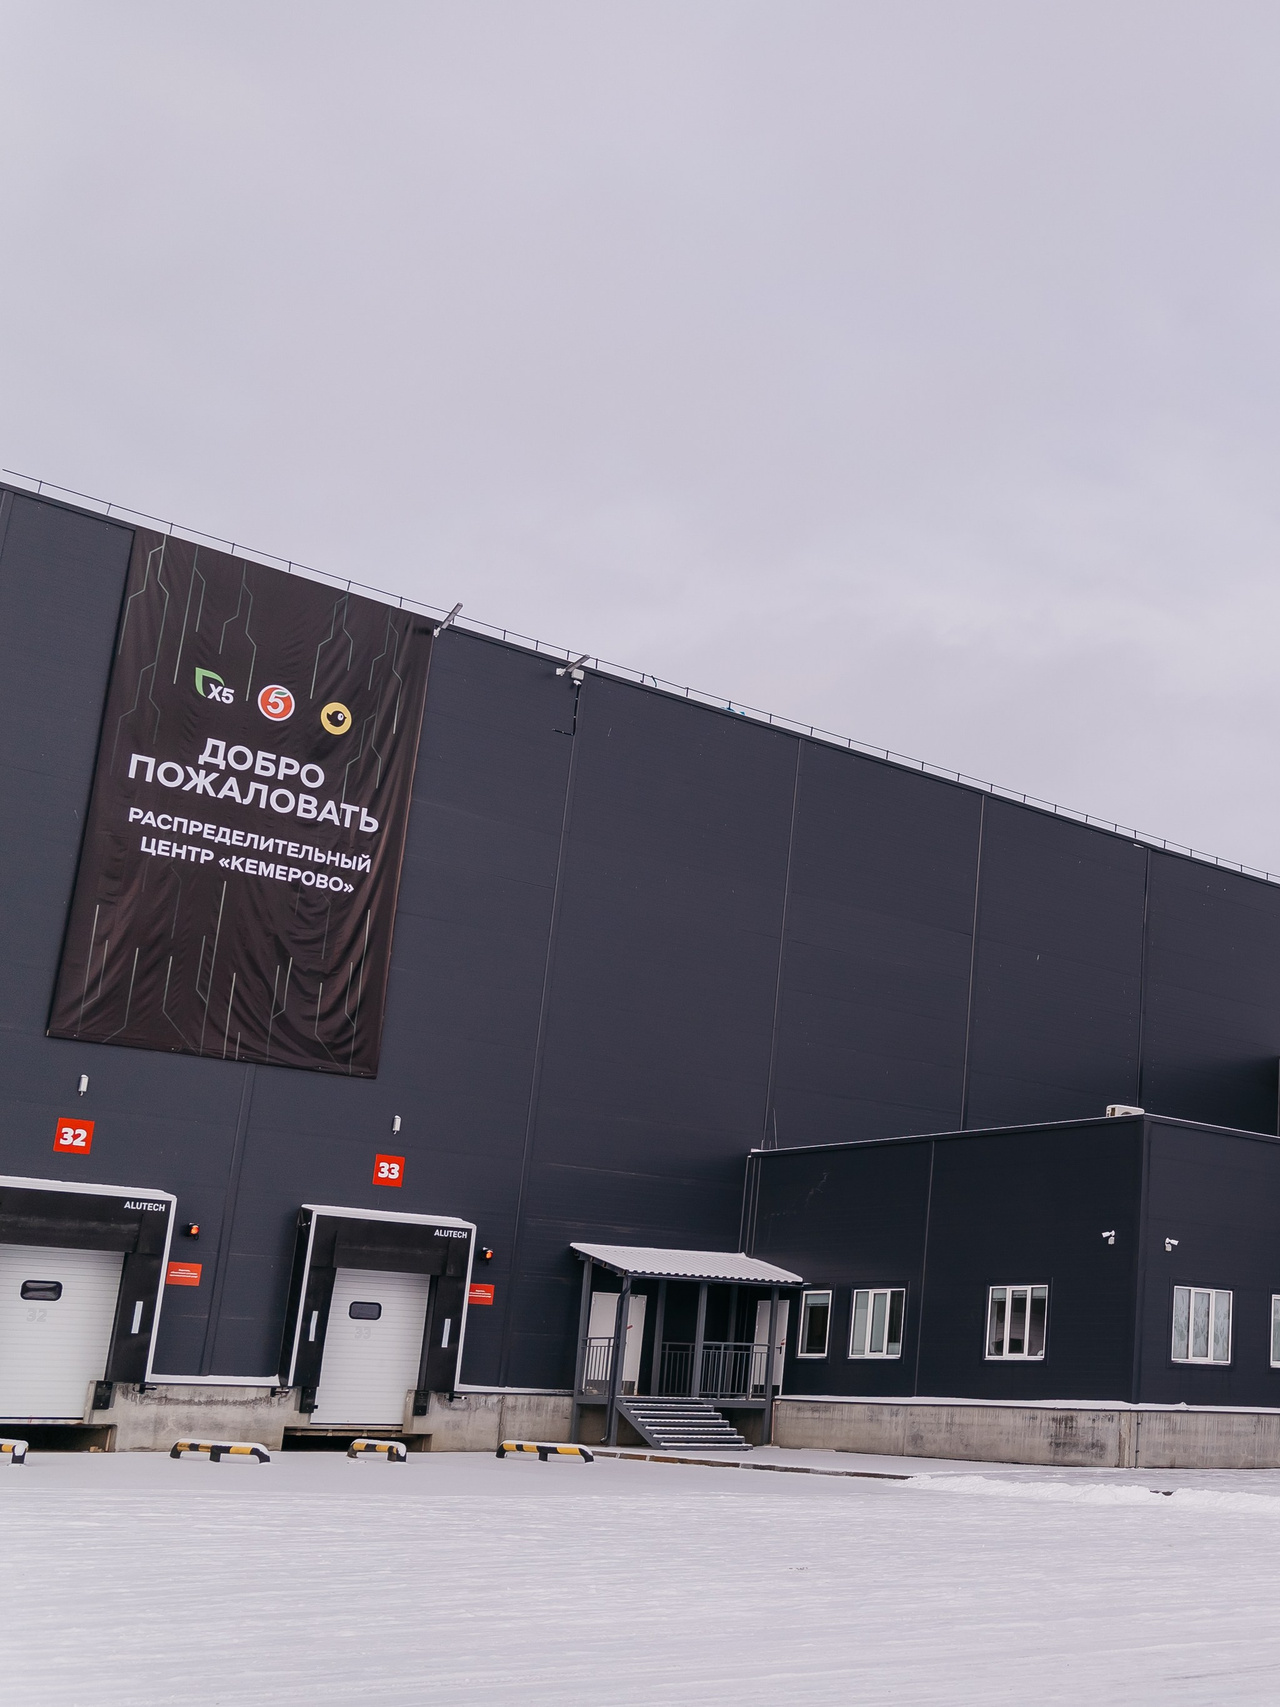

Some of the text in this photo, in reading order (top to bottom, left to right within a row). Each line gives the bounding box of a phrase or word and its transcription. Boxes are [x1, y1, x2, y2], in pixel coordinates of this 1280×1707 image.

[207, 683, 235, 705] X5
[266, 689, 290, 714] 5
[198, 738, 325, 788] ДОБРО
[128, 753, 379, 833] ПОЖАЛОВАТЬ
[128, 807, 372, 873] РАСПРЕДЕЛИТЕЛЬНЫЙ
[140, 836, 355, 893] ЦЕНТР «КЕМЕРОВО»
[59, 1127, 88, 1147] 32
[377, 1162, 400, 1180] 33
[123, 1200, 166, 1212] ALUTECH
[433, 1229, 468, 1239] ALUTECH
